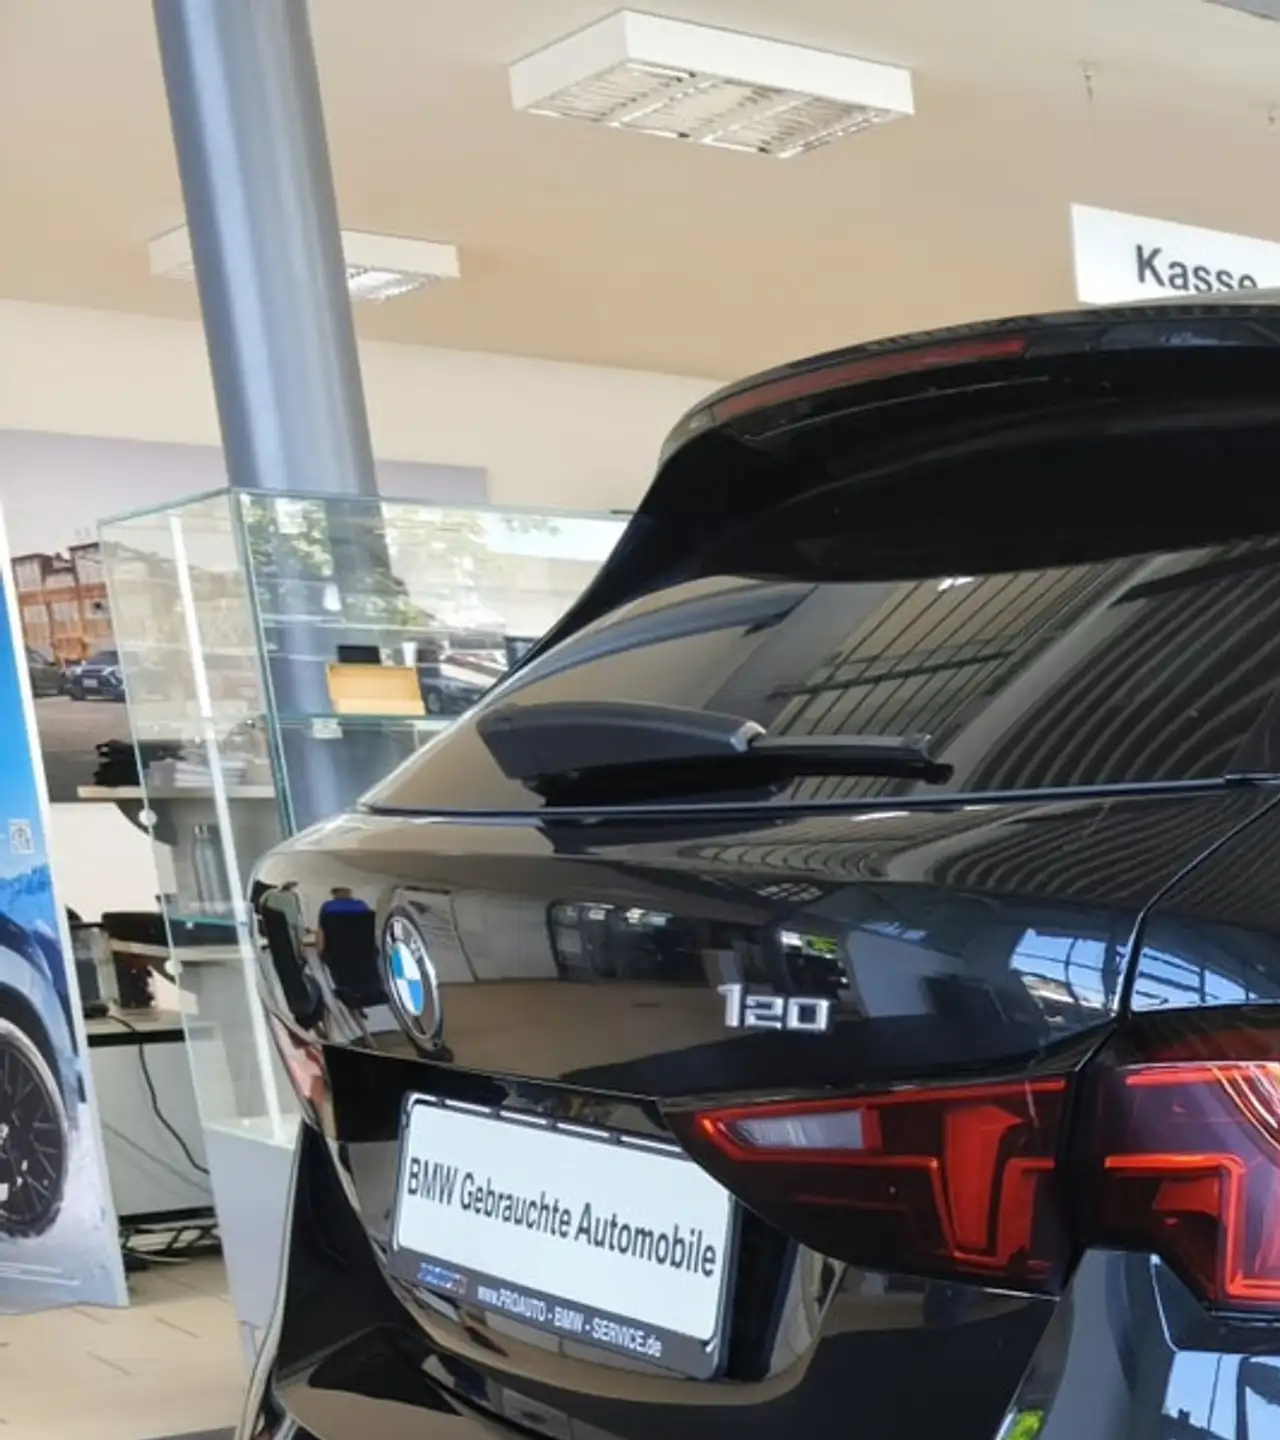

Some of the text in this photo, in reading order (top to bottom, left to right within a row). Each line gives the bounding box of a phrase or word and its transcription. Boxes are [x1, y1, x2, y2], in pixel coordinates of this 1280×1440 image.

[1135, 244, 1258, 294] Kasse
[716, 983, 831, 1031] 120
[407, 1156, 717, 1278] BMW Gebrauchte Automobile
[591, 1317, 663, 1359] SERVICE.de
